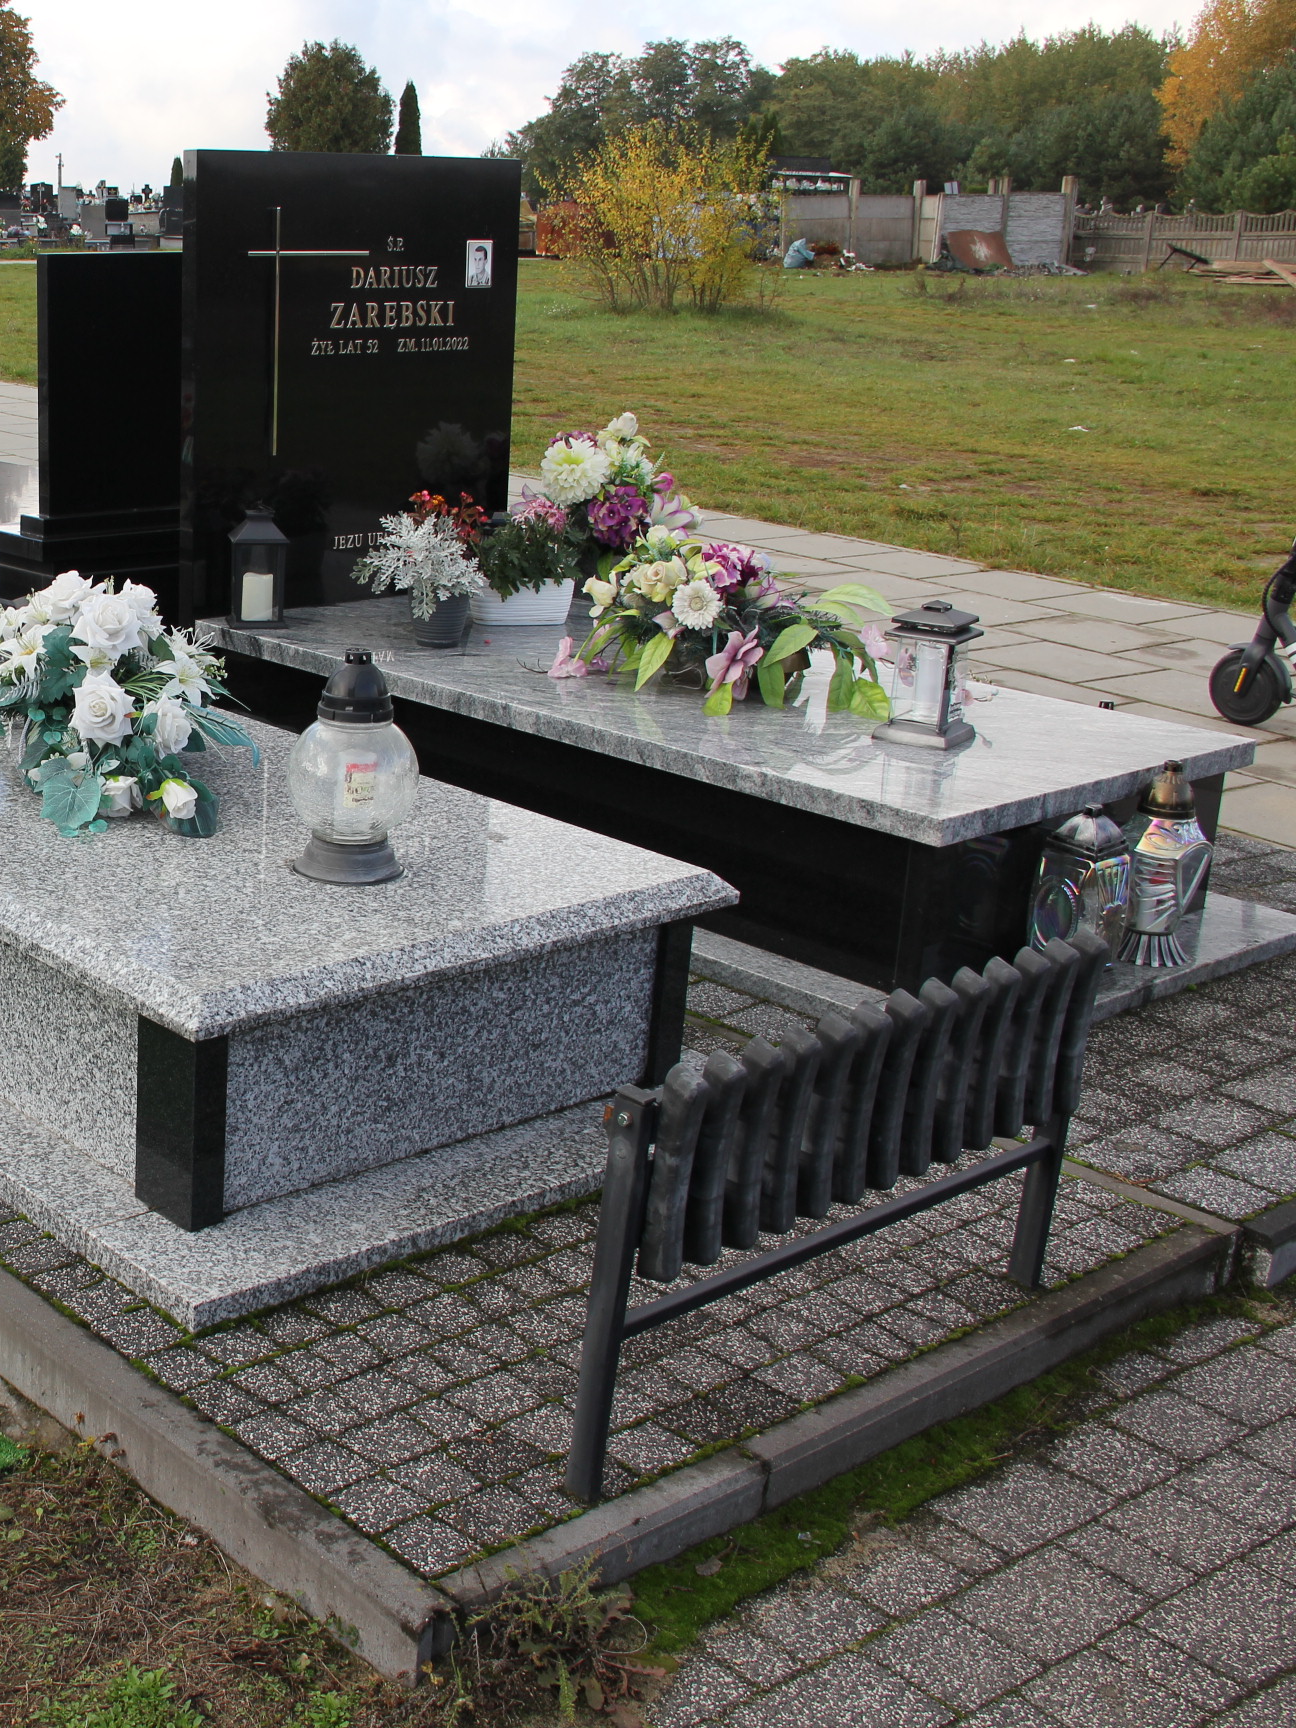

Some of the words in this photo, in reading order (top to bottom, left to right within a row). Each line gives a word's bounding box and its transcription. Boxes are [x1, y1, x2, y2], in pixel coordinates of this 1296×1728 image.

[387, 235, 405, 252] Ś.P.
[350, 266, 438, 289] DARIUSZ
[329, 301, 455, 330] ZARĘBSKI
[310, 338, 335, 356] ŻYŁ
[338, 340, 363, 355] LAT
[366, 339, 379, 354] 52
[397, 338, 418, 353] ZM.
[420, 336, 470, 352] 11.01.2022
[332, 533, 364, 550] JEZU
